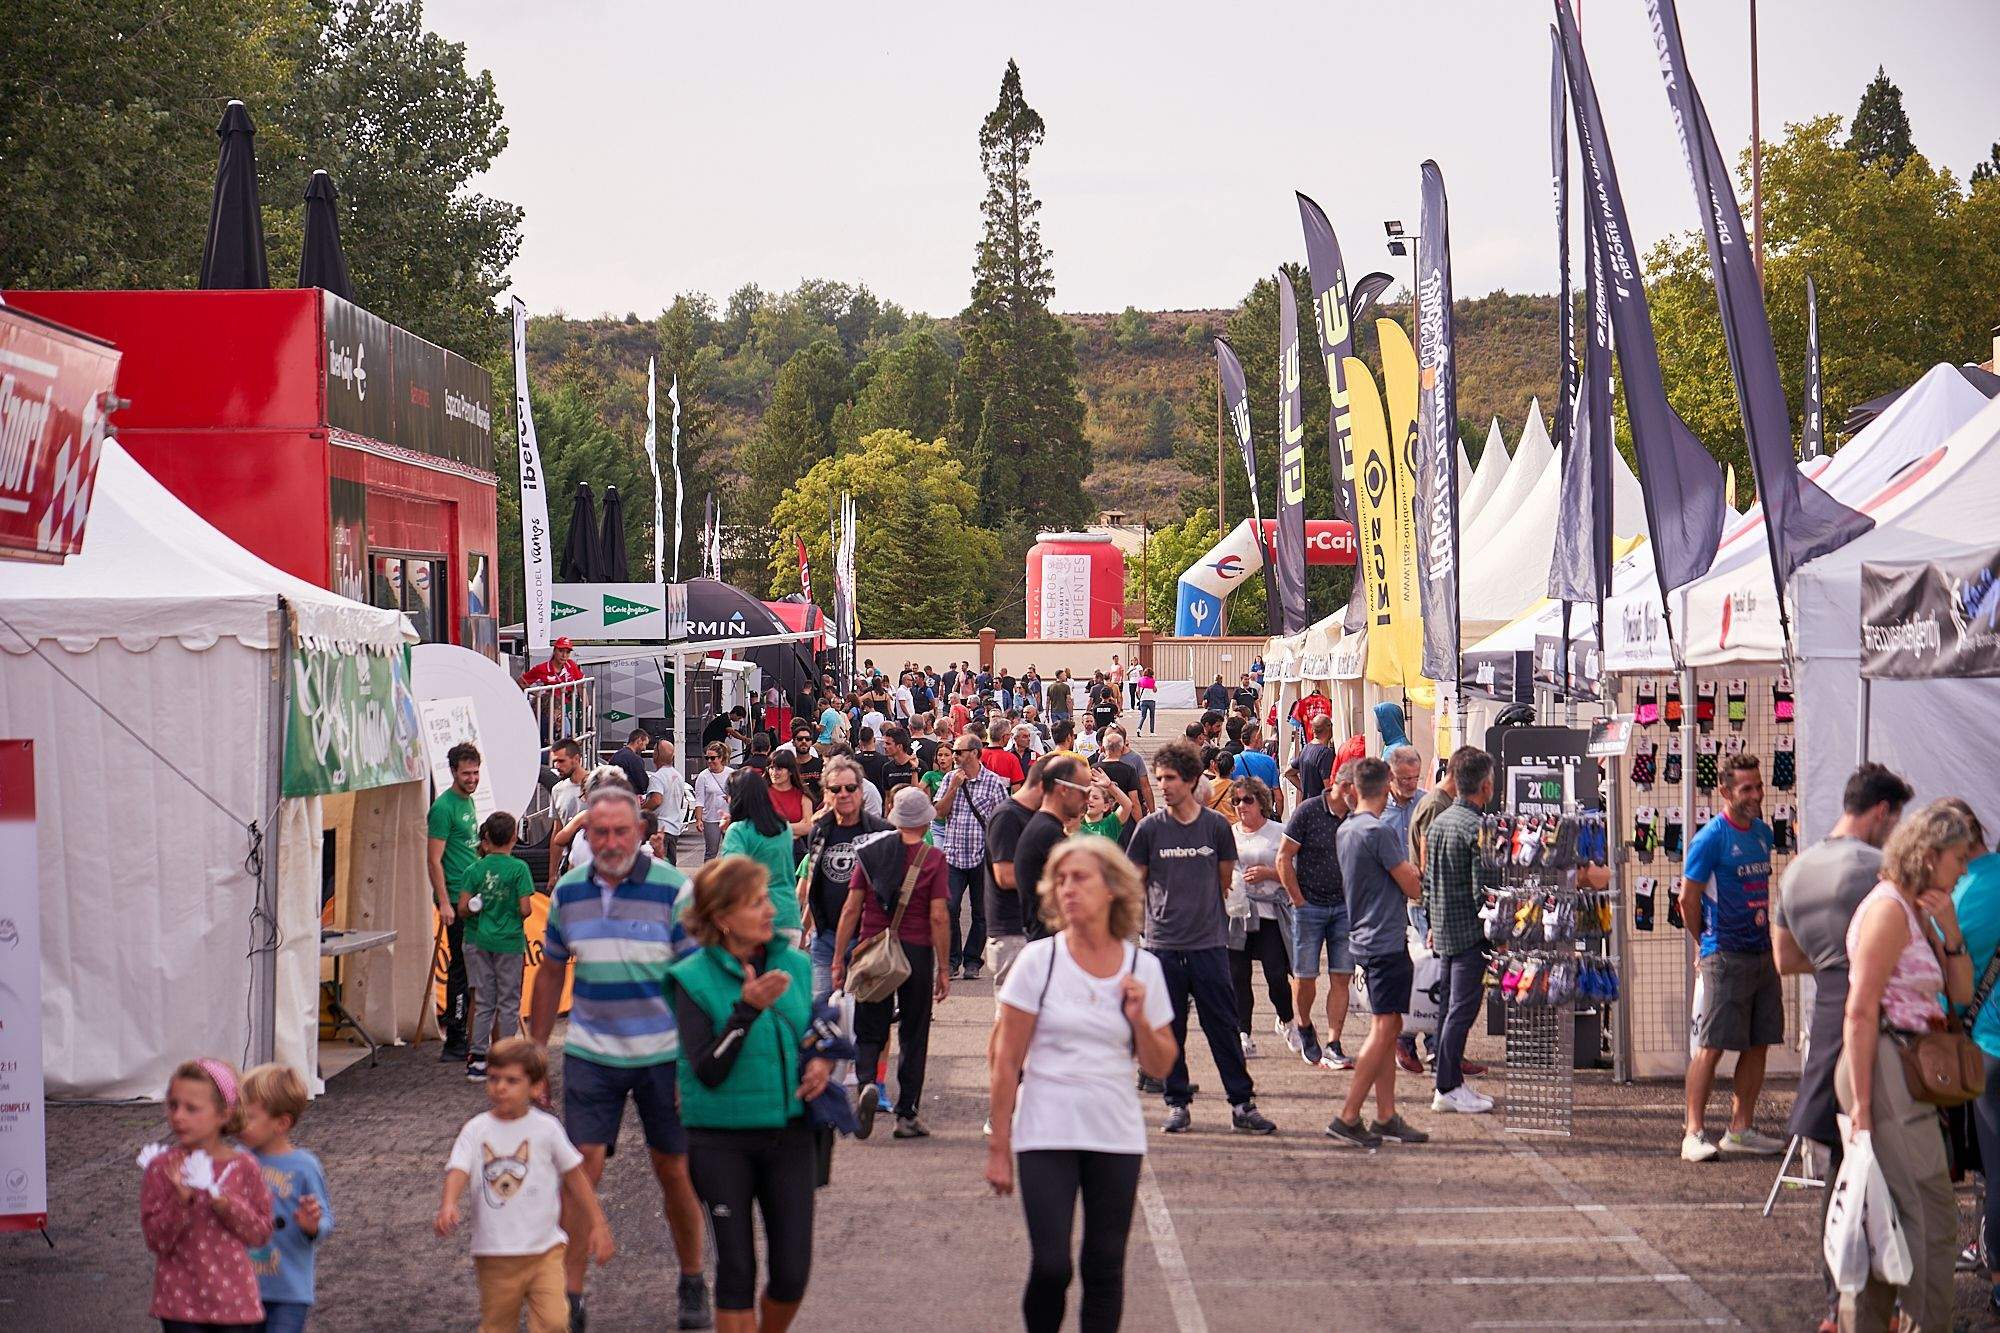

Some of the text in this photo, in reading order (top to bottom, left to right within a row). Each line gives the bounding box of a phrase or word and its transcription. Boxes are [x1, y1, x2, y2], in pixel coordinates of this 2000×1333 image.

[1272, 530, 1357, 554] irCaj
[1046, 573, 1057, 637] VECEROS
[1072, 557, 1085, 637] ENDIENTES
[1159, 846, 1197, 859] umbro
